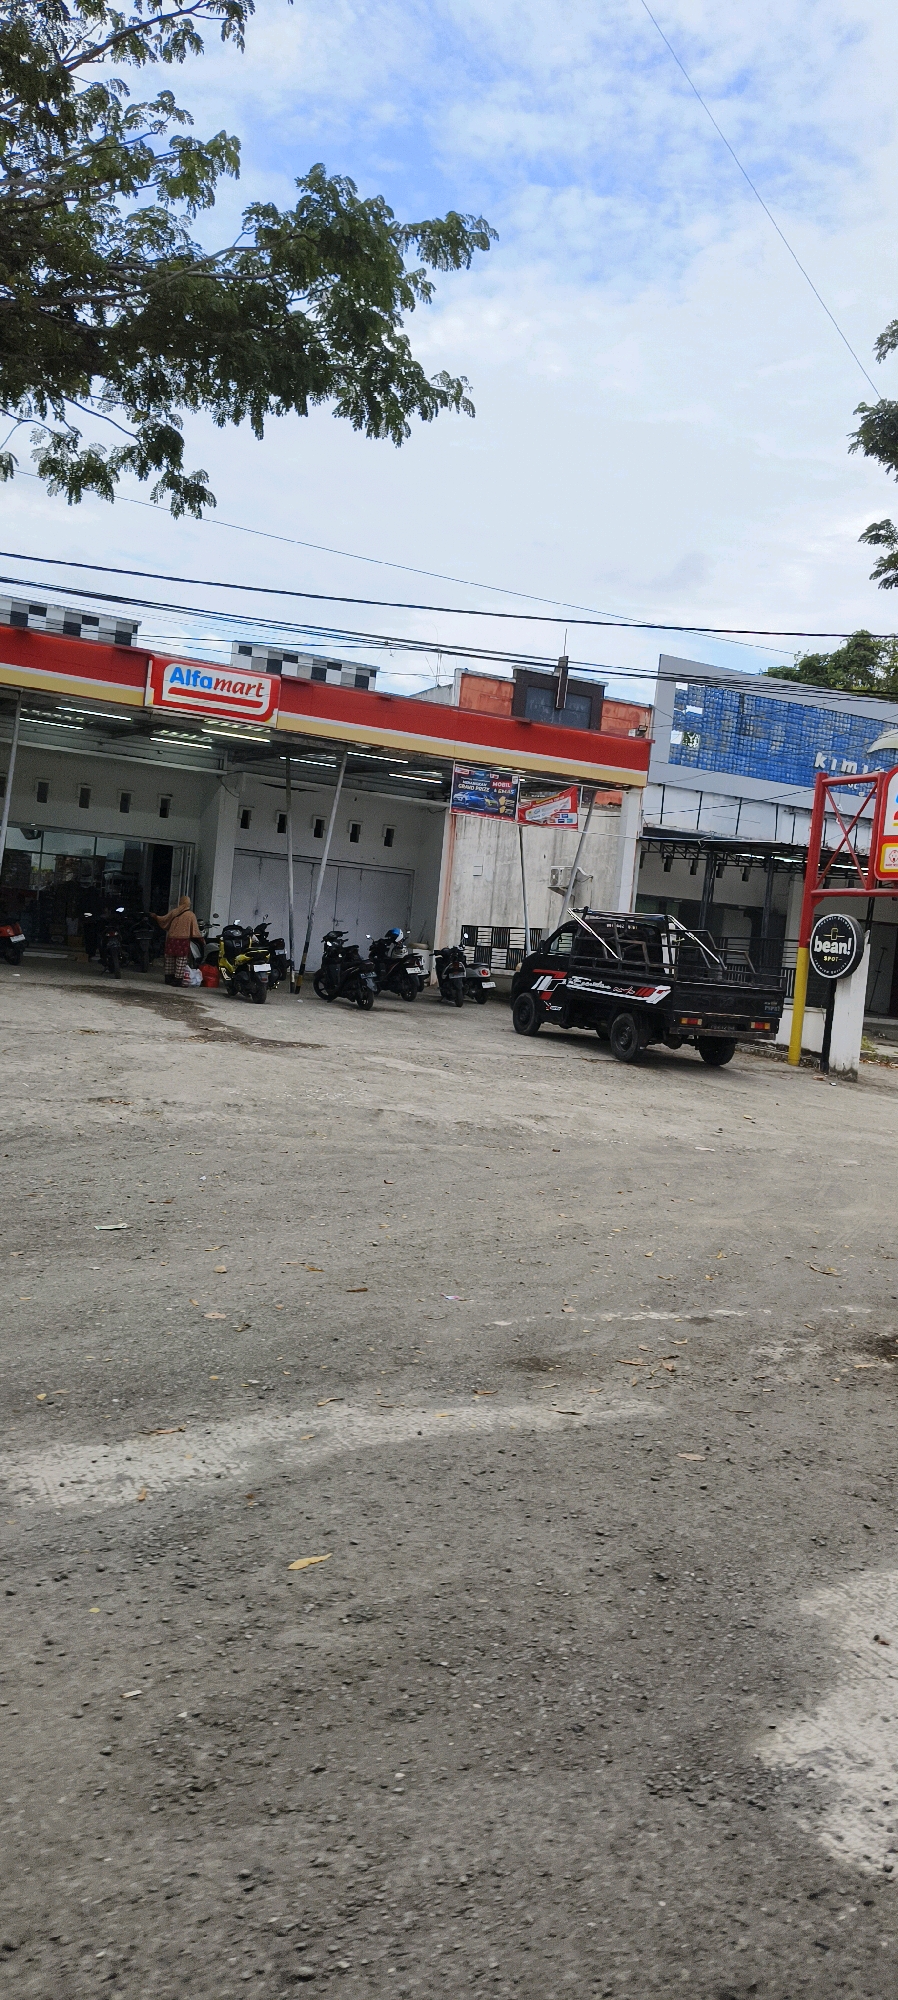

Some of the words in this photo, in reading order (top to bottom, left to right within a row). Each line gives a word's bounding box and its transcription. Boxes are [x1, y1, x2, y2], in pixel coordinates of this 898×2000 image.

[169, 666, 265, 698] Alfamart
[458, 783, 475, 791] GRAND
[813, 935, 852, 956] bean!
